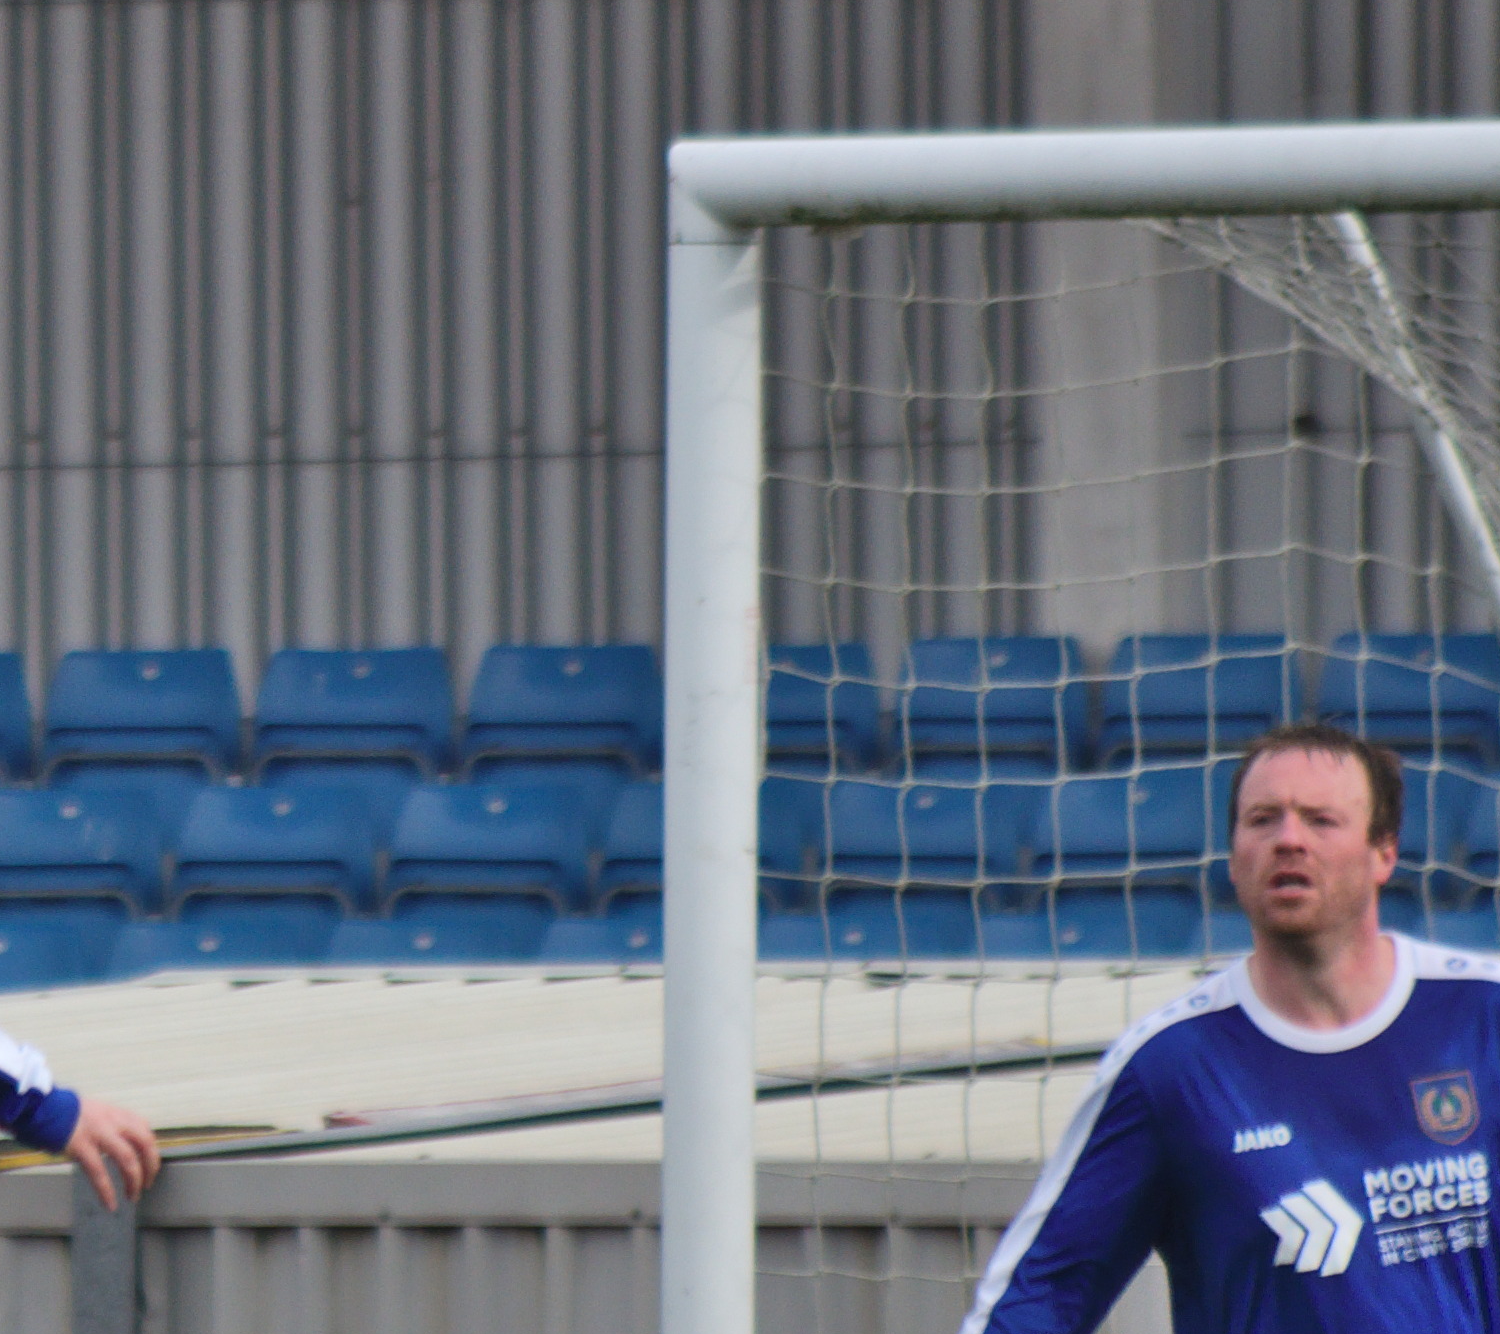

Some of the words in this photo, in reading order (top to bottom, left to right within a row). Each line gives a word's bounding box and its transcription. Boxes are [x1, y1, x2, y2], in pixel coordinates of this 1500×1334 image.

[1233, 1123, 1292, 1154] JAKO
[1363, 1152, 1489, 1198] MOVING
[1368, 1178, 1491, 1224] FORCES
